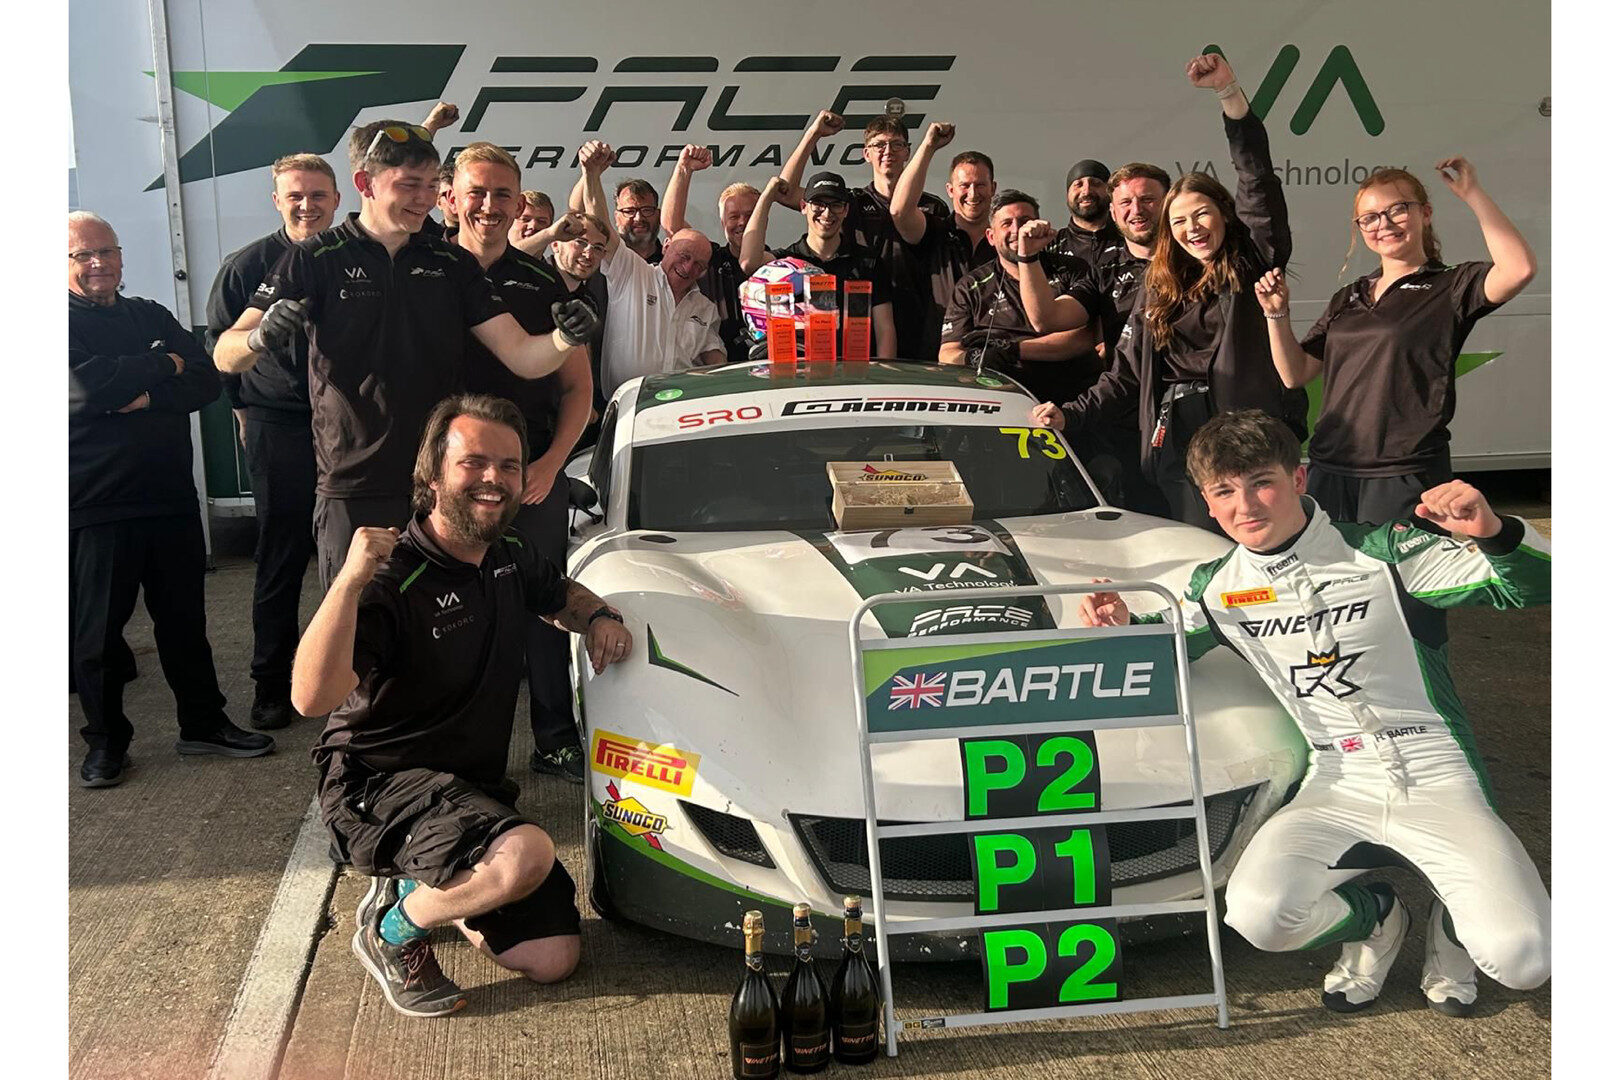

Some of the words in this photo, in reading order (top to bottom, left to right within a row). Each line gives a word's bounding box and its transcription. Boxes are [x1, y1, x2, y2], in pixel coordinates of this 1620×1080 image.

[460, 55, 957, 133] PACE
[677, 406, 763, 429] SRO
[999, 428, 1067, 460] 73
[865, 473, 922, 481] SUNOCO
[898, 563, 998, 581] VA
[1266, 552, 1299, 576] freem
[436, 592, 460, 609] VA
[907, 617, 1029, 638] PERFORMANCE
[910, 605, 1034, 633] PACE
[1238, 600, 1371, 638] GINETTA
[946, 662, 1154, 707] BARTLE
[1386, 725, 1427, 739] BARTLE
[595, 738, 687, 786] PIRELLI
[964, 736, 1096, 816] P2
[604, 803, 664, 831] SUNOCO
[974, 829, 1096, 911] P1
[984, 924, 1118, 1009] P2
